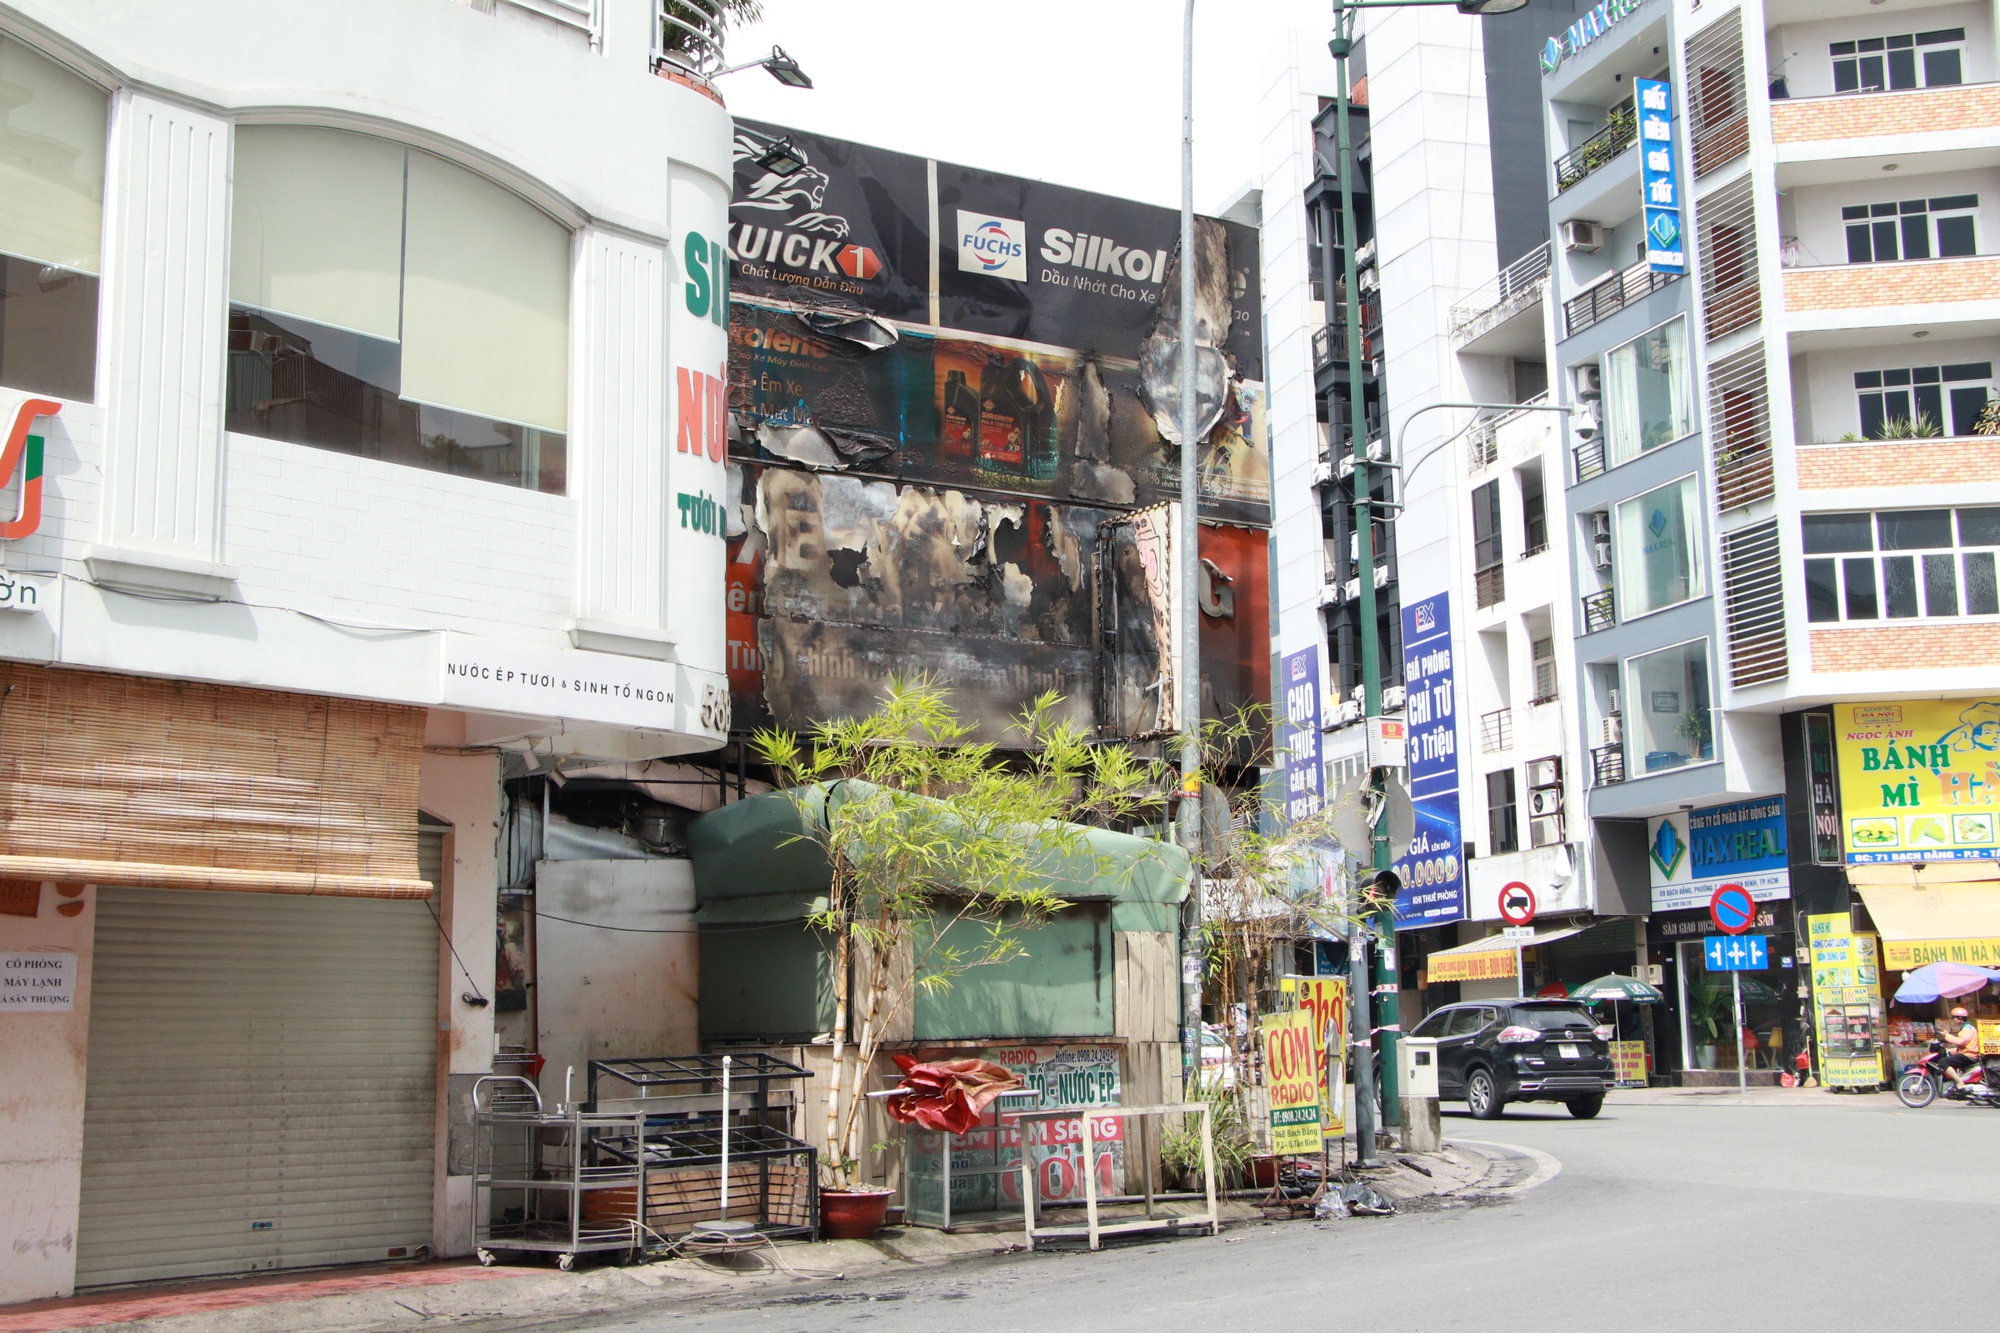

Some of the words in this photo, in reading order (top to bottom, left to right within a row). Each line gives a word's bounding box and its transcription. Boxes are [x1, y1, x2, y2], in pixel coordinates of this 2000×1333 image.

[1648, 148, 1670, 172] GIÁ
[962, 233, 1022, 258] FUCHS
[848, 246, 865, 279] 1
[741, 263, 769, 280] Chất
[772, 268, 809, 288] Lượng
[812, 275, 837, 291] Dẫn
[840, 280, 864, 296] Đầu
[1041, 268, 1069, 288] Dầu
[1073, 275, 1106, 297] Nhớt
[1110, 283, 1136, 301] Cho
[1139, 289, 1156, 305] Xe
[767, 355, 788, 367] Máy
[761, 371, 782, 392] Êm
[786, 379, 803, 397] Xe
[1406, 654, 1420, 683] GIÁ
[1422, 648, 1450, 679] PHÒNG
[448, 662, 490, 680] NƯỚC
[496, 666, 515, 683] ÉP
[520, 672, 555, 689] TƯƠI
[561, 680, 567, 689] &
[573, 679, 608, 696] SINH
[613, 682, 631, 698] TỐ
[636, 688, 674, 704] NGON
[1287, 682, 1314, 725] CHO
[1408, 680, 1431, 727] CHỈ
[1434, 677, 1453, 720] TỪ
[1289, 720, 1317, 764] THUÊ
[1410, 736, 1420, 764] 3
[1421, 725, 1454, 763] Triệu
[1846, 731, 1883, 742] NGỌC
[1885, 729, 1914, 739] ÁNH
[1861, 739, 1951, 771] BÁNH
[1815, 779, 1833, 804] HÀ
[1880, 776, 1921, 807] MÌ
[1689, 815, 1704, 829] CÔNG
[1706, 816, 1713, 827] TY
[1721, 809, 1738, 824] PHẦN
[1750, 806, 1766, 822] ĐỘNG
[1767, 801, 1780, 817] SẢN
[1409, 831, 1430, 856] GIÁ
[1690, 828, 1785, 867] MAXREAL
[1855, 853, 1873, 863] ĐC:
[1875, 853, 1888, 862] 71
[1891, 852, 1921, 863] BẠCH
[1923, 849, 1954, 860] ĐẰNG
[1964, 849, 1980, 858] P.2
[1760, 877, 1779, 886] TP.HCM
[1413, 895, 1422, 905] KHI
[1423, 891, 1436, 904] THUÊ
[1437, 889, 1458, 901] PHÒNG
[1662, 921, 1678, 936] SÀN
[1679, 921, 1696, 934] GIAO
[1757, 910, 1774, 927] SẢN
[6, 958, 22, 969] CÓ
[24, 958, 62, 969] PHÒNG
[1913, 943, 1948, 964] BÁNH
[1951, 941, 1967, 962] MÌ
[1970, 940, 1989, 961] HÀ
[4, 976, 29, 987] MÁY
[32, 978, 62, 989] LẠNH
[9, 994, 28, 1004] SÂN
[30, 994, 70, 1005] THƯỢNG
[1055, 1050, 1077, 1064] Hotline:
[1268, 1018, 1312, 1081] CƠM
[1059, 1065, 1095, 1105] NƯỚC
[1099, 1064, 1115, 1103] ÉP
[1271, 1081, 1315, 1106] RADIO
